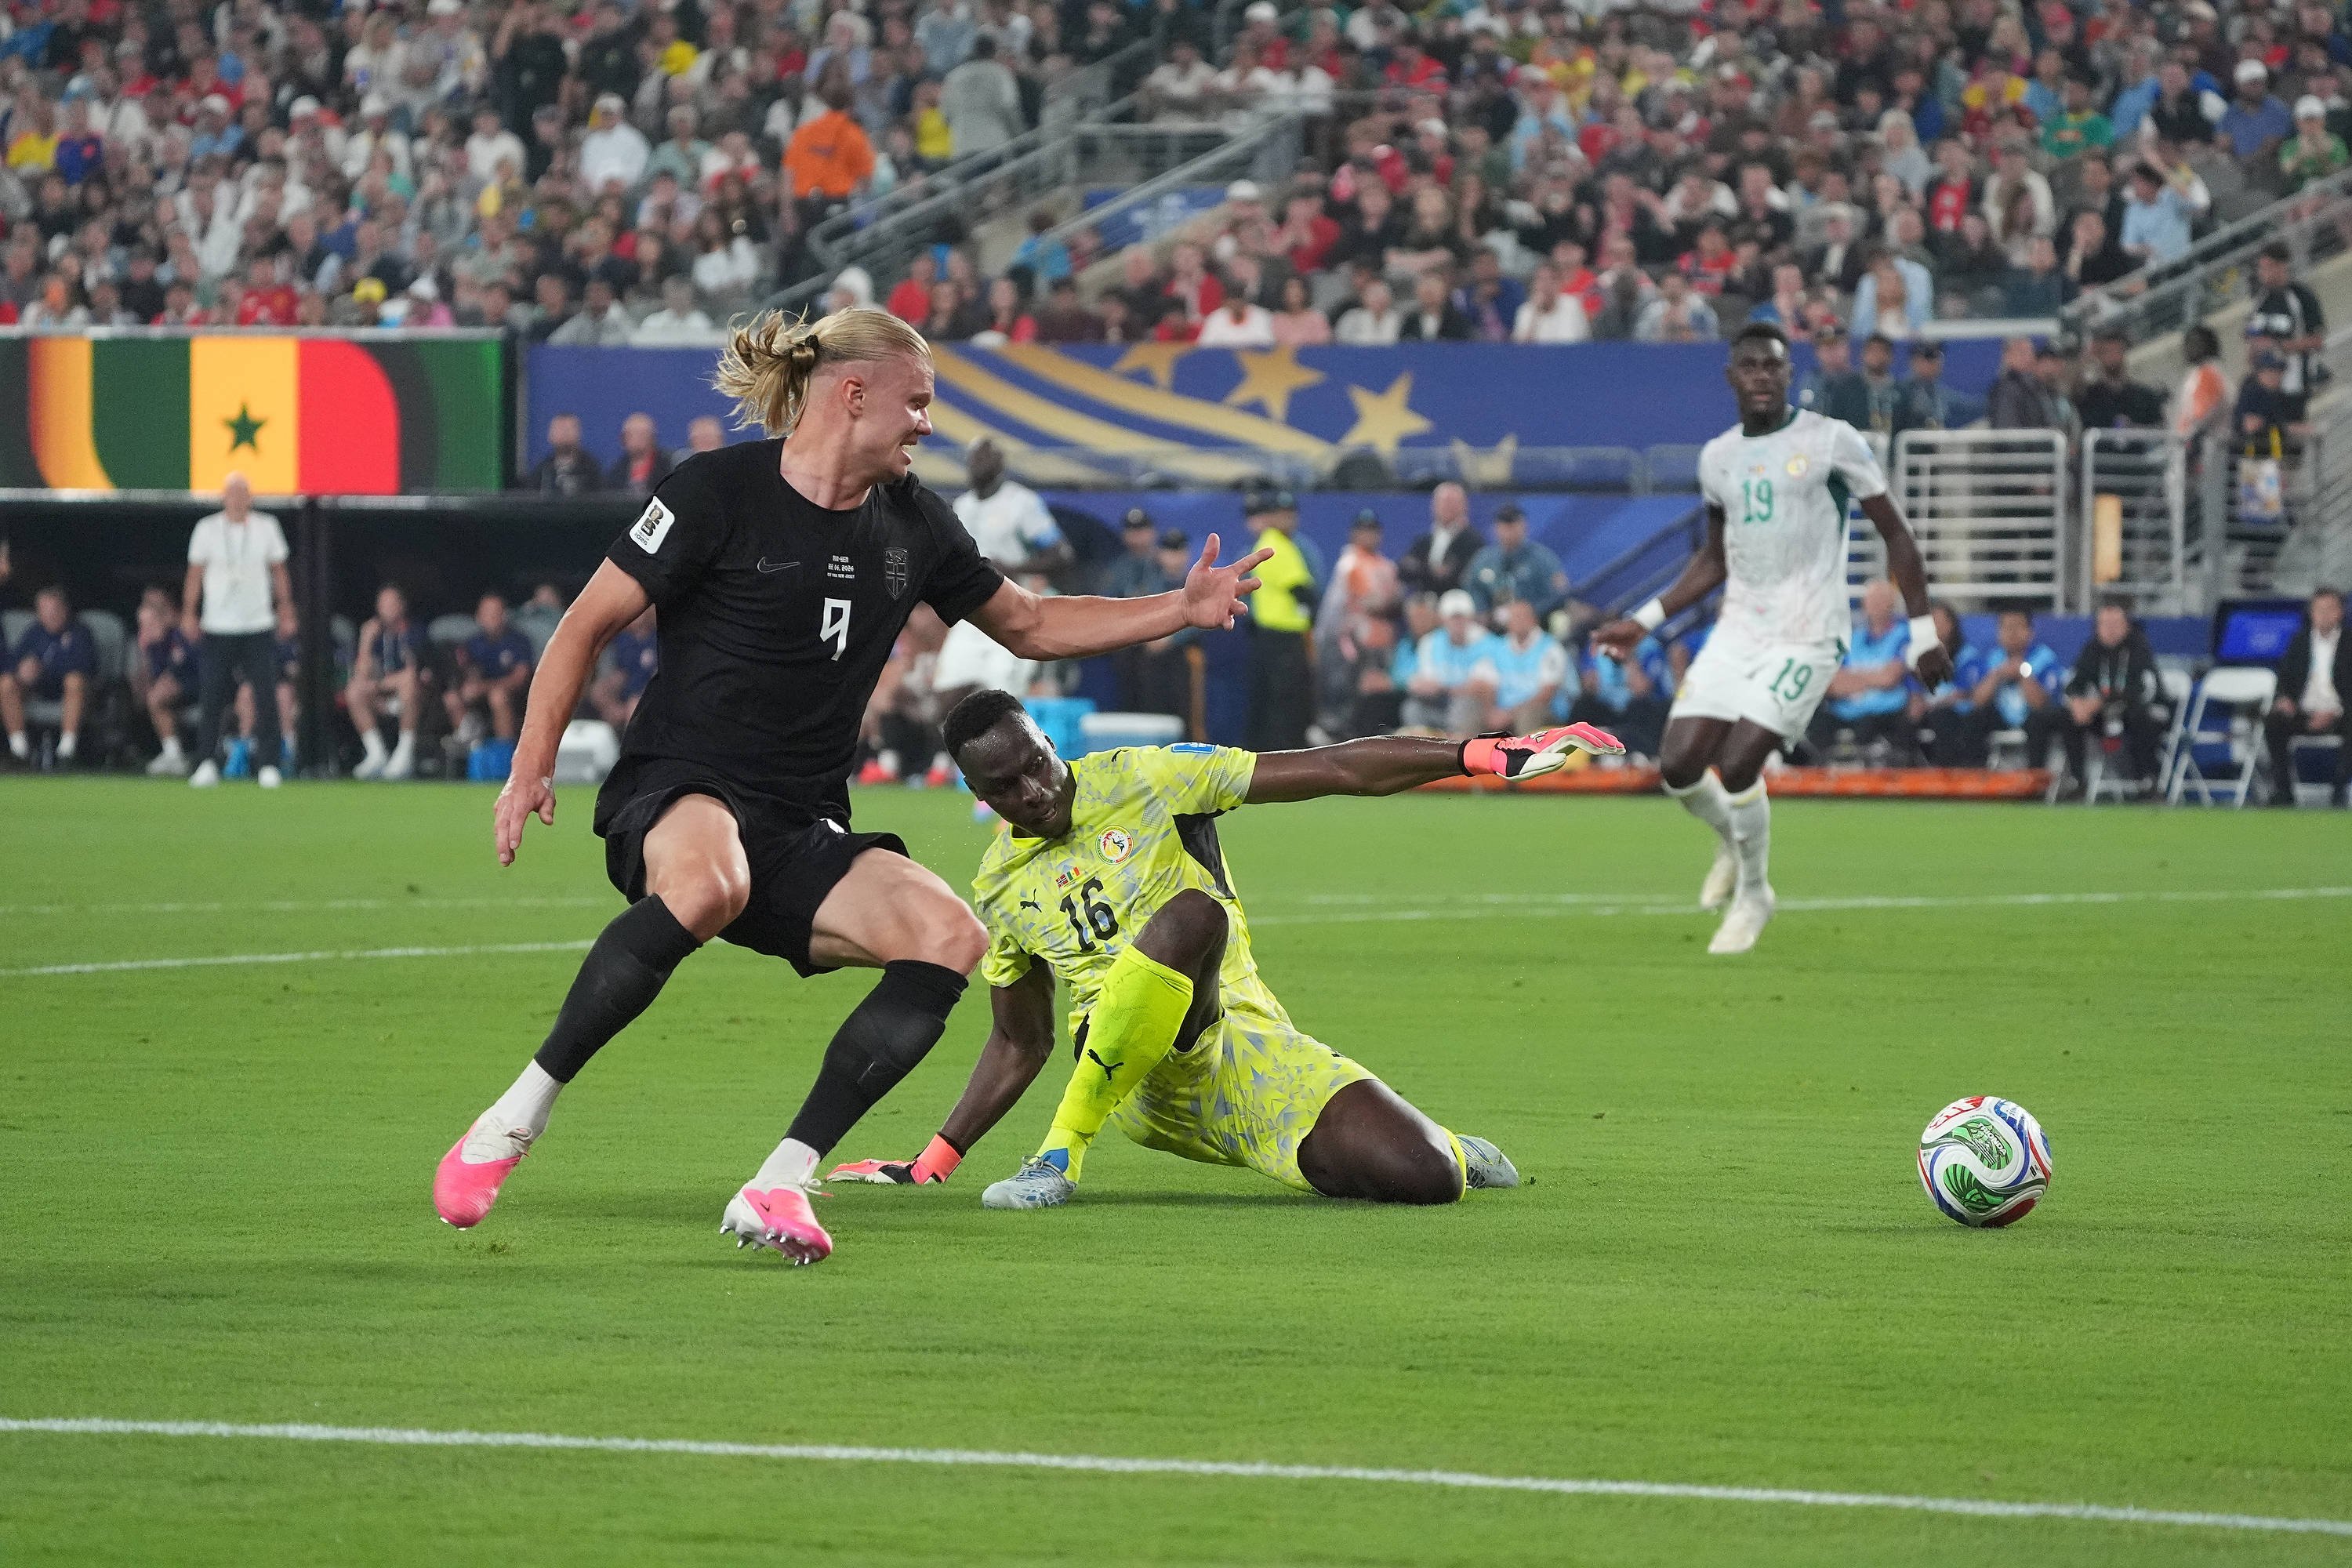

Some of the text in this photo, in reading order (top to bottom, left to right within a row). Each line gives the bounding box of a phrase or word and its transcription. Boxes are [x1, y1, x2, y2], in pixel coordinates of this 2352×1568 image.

[1743, 479, 1773, 524] 19
[820, 597, 851, 662] 9
[1769, 658, 1812, 700] 19
[1060, 876, 1119, 953] 16
